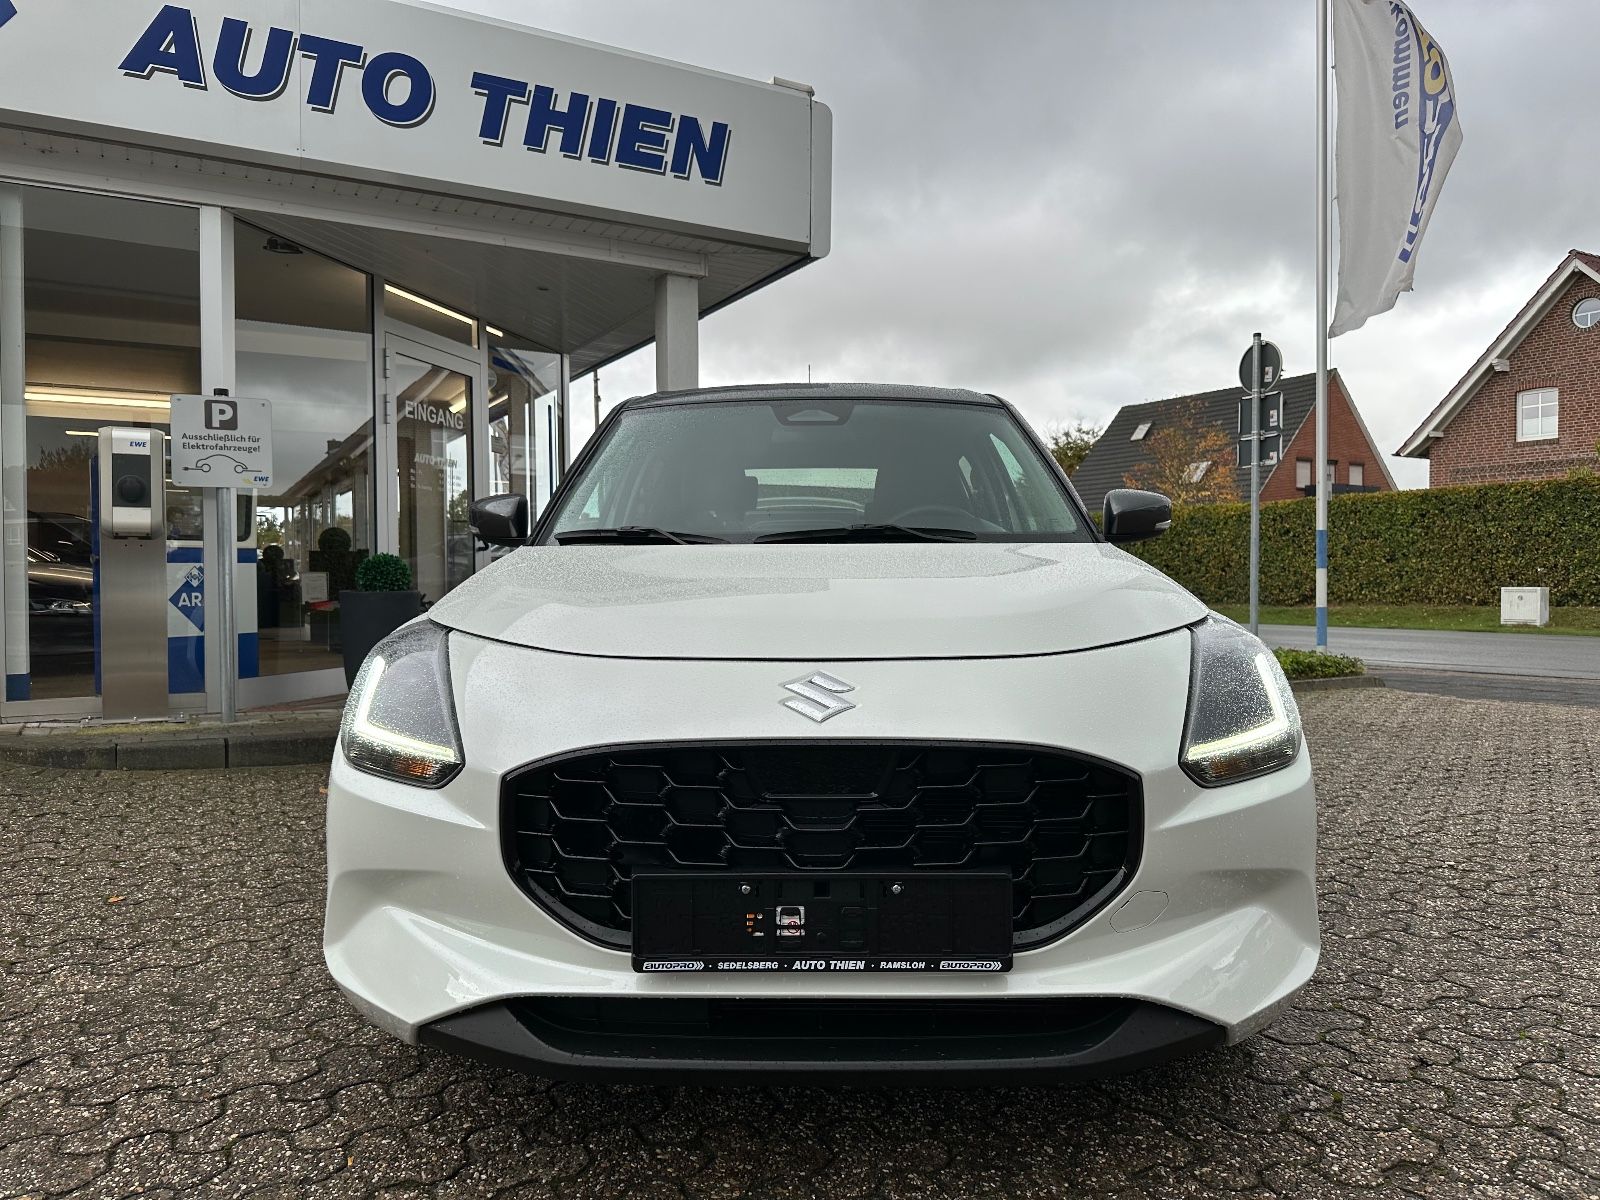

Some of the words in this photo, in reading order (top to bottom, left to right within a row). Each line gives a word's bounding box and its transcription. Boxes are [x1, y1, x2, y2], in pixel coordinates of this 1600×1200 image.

[118, 5, 435, 127] AUTO
[471, 72, 731, 186] THIEN
[211, 402, 234, 428] P
[405, 400, 464, 430] EINGANG
[181, 432, 246, 443] Ausschließlich
[247, 435, 262, 443] für
[182, 442, 261, 454] Elektrofahrzeuge!
[414, 453, 435, 467] AUTO
[177, 592, 204, 608] AR
[717, 961, 779, 970] SEDELSBERG
[792, 960, 826, 970] AUTO
[830, 960, 866, 970] THIEN
[880, 961, 926, 970] RAMSLOH
